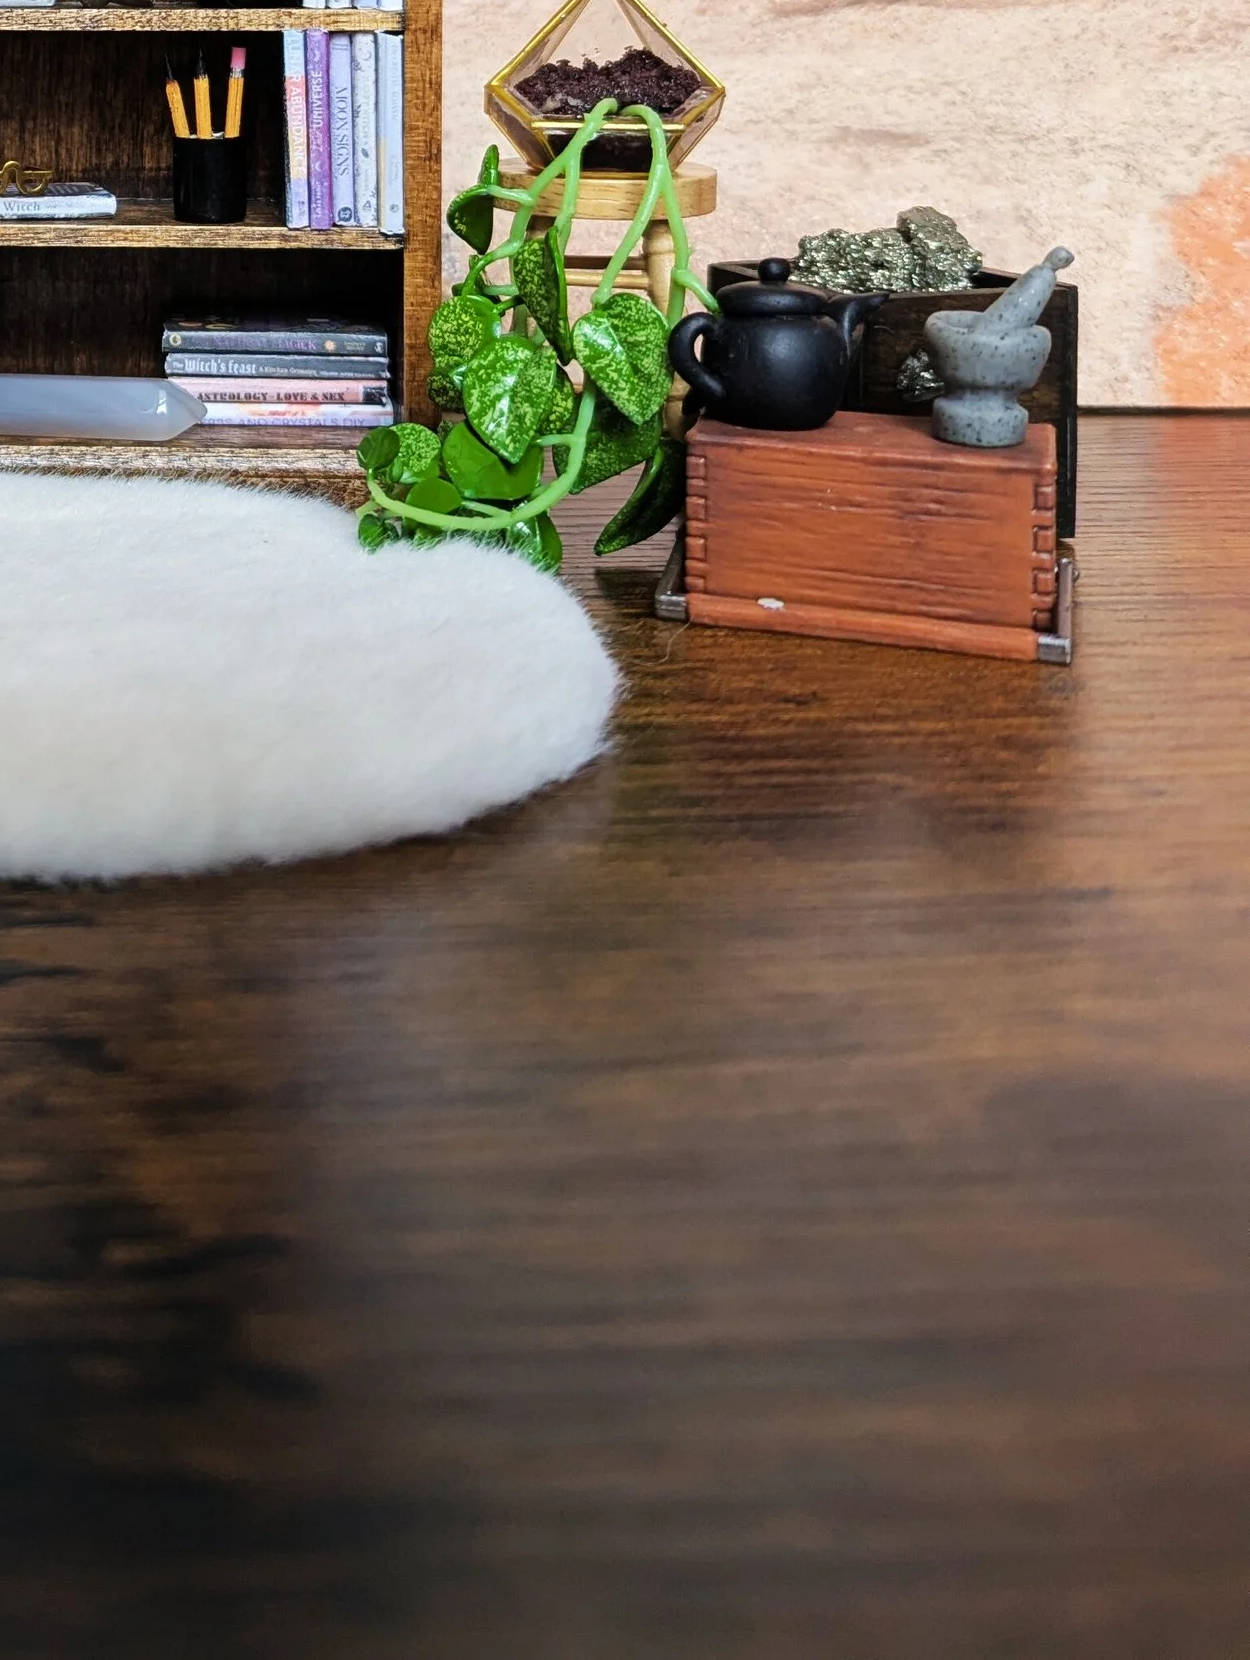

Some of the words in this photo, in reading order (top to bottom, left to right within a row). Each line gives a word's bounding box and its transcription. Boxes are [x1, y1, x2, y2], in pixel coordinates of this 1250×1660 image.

[288, 37, 300, 82] LUNAR
[311, 71, 323, 127] UNIVERSE
[335, 86, 349, 131] MOON
[291, 87, 303, 175] ABUNDANCE
[336, 134, 350, 176] SIGNS
[3, 202, 40, 211] Witch
[184, 359, 227, 372] Witch's
[229, 359, 256, 374] feast
[197, 392, 267, 401] ASTROLOGY
[277, 393, 307, 401] LOVE
[322, 392, 344, 401] SEX
[342, 418, 366, 426] DIY
